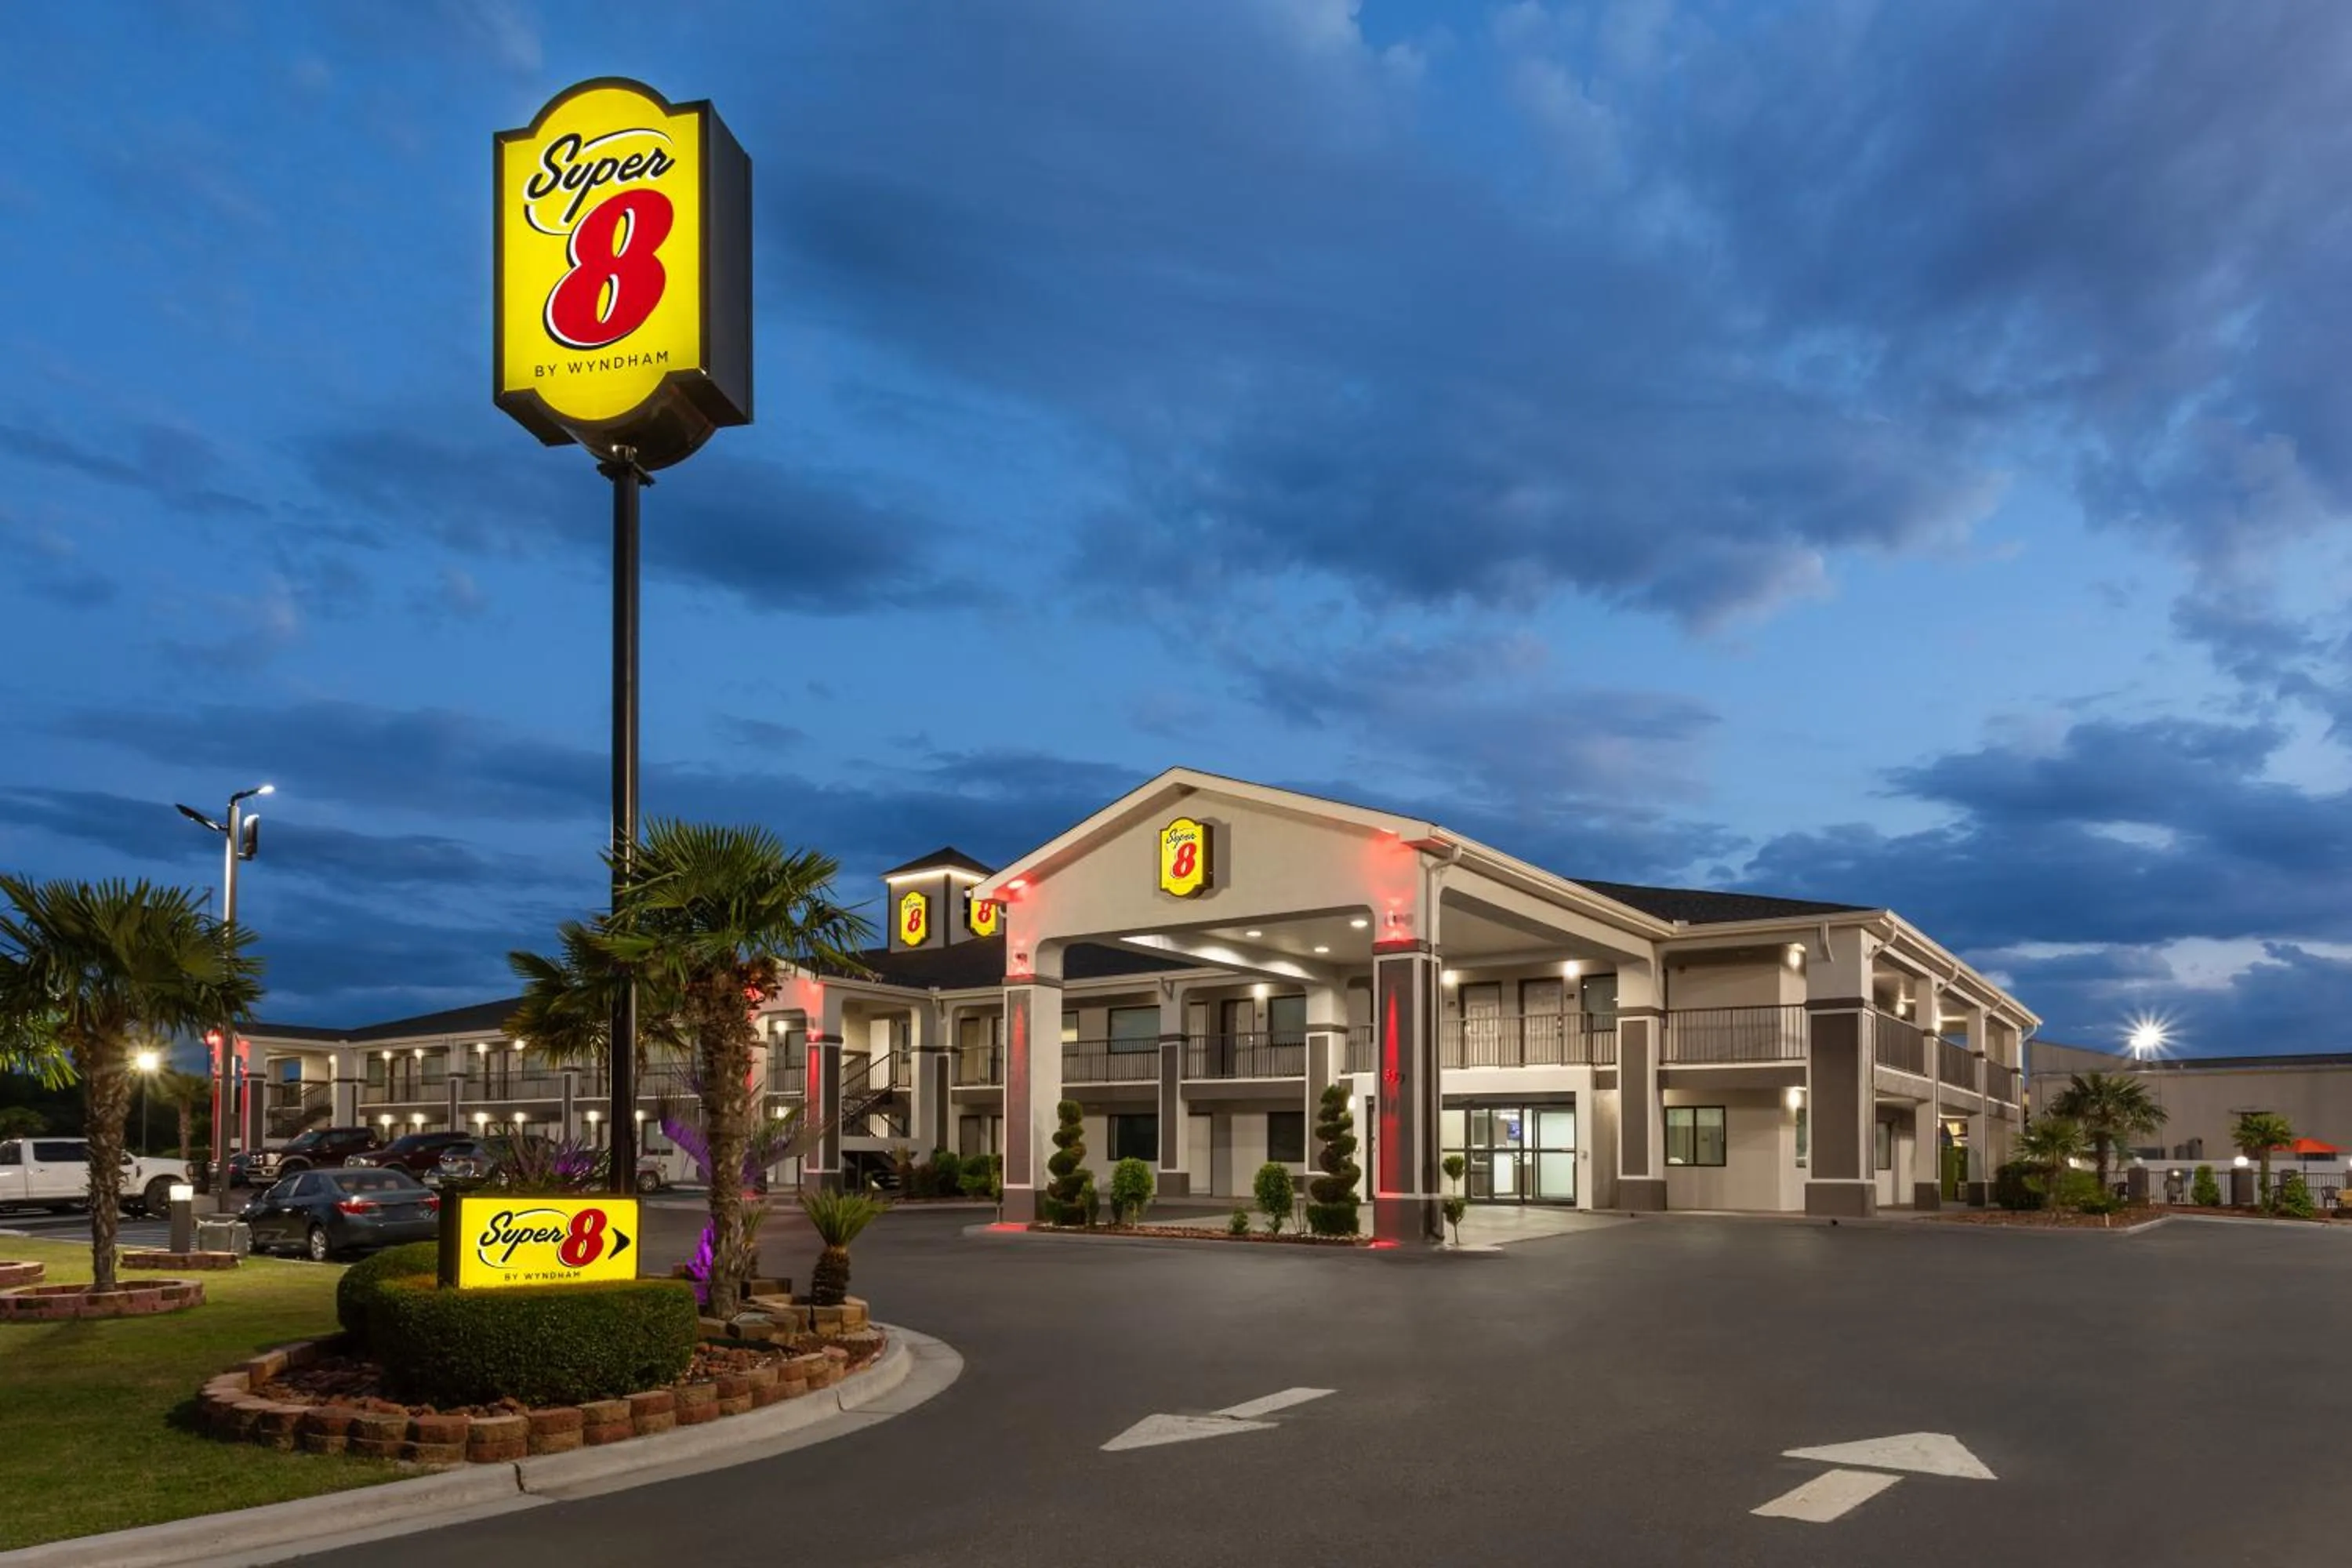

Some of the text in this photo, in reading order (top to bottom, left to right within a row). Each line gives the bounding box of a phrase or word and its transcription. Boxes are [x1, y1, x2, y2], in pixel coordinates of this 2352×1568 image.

[526, 132, 675, 224] Super
[543, 188, 674, 350] 8
[535, 350, 669, 377] BY WYNDHAM
[1166, 828, 1196, 849] Super
[1172, 841, 1197, 878] 8
[907, 908, 922, 932] 8
[978, 901, 992, 924] 8
[478, 1208, 608, 1267] Super 8
[504, 1271, 580, 1281] BY WYNDHAM
